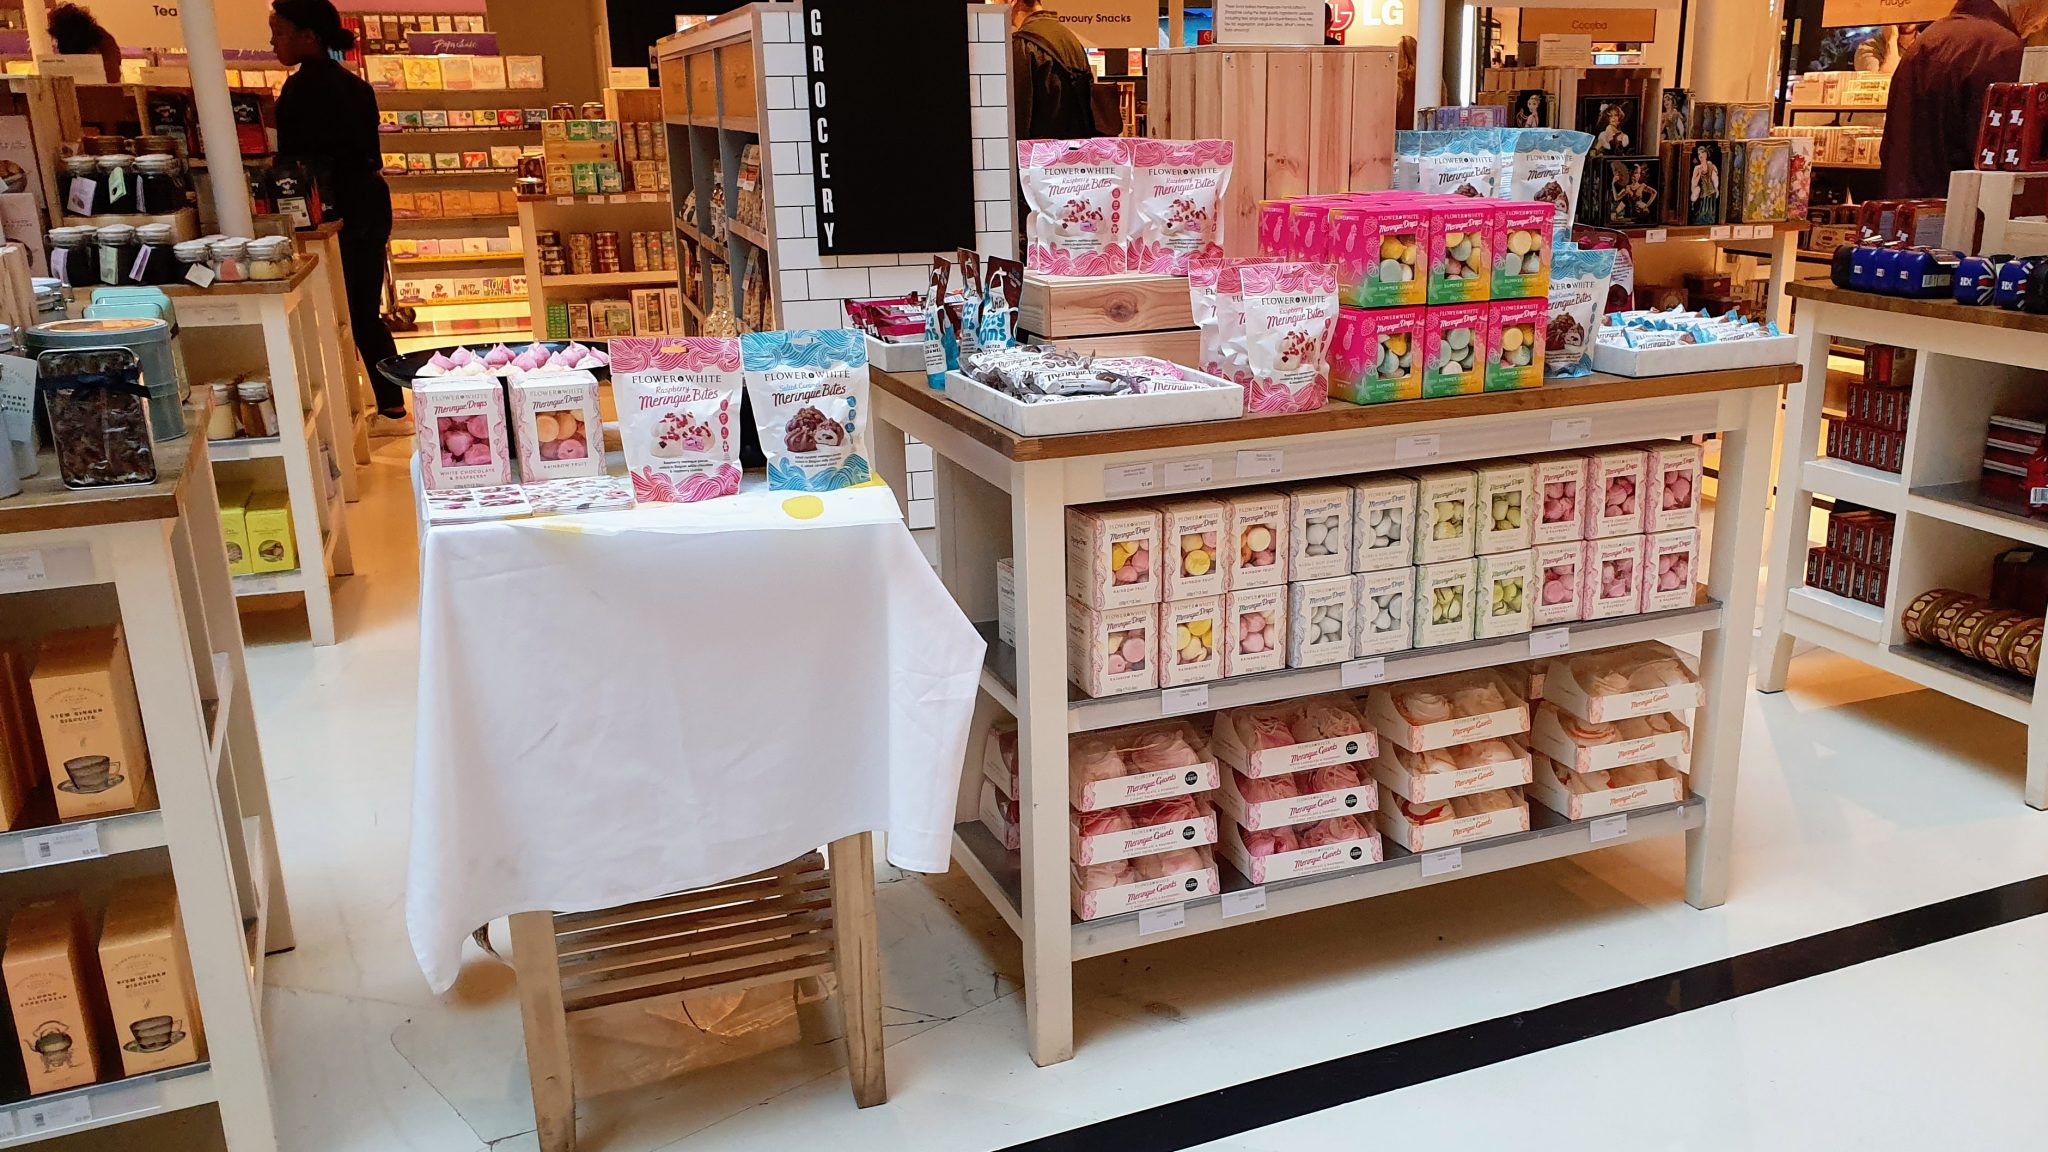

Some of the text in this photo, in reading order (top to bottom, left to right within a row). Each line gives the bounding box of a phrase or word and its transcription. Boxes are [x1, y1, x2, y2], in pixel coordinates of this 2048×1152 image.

[153, 5, 178, 17] Tea
[1363, 0, 1404, 26] LG
[1058, 12, 1131, 25] avoury Snacks
[810, 8, 836, 248] GROCERY
[1045, 167, 1116, 176] FLOWER WHITE
[1148, 168, 1182, 176] FLOWER
[1439, 170, 1476, 185] Meringue
[1527, 169, 1560, 181] Meringue
[1048, 178, 1112, 198] Meringue Bites
[1153, 177, 1216, 198] Meringue Bites
[1572, 281, 1595, 289] WHITE
[1261, 297, 1295, 305] FLOWER
[1548, 292, 1592, 311] eringue Bites
[1266, 308, 1325, 329] Meringue Bites
[632, 375, 678, 383] FLOWER
[764, 370, 851, 381] FLOWER WHITE
[1045, 369, 1089, 382] Meringue
[656, 386, 690, 395] Raspberry
[772, 383, 847, 407] Meringue Bites
[533, 394, 584, 409] Meringue Drops
[639, 388, 719, 410] Meringue Bites
[434, 400, 487, 415] Meringue Drops
